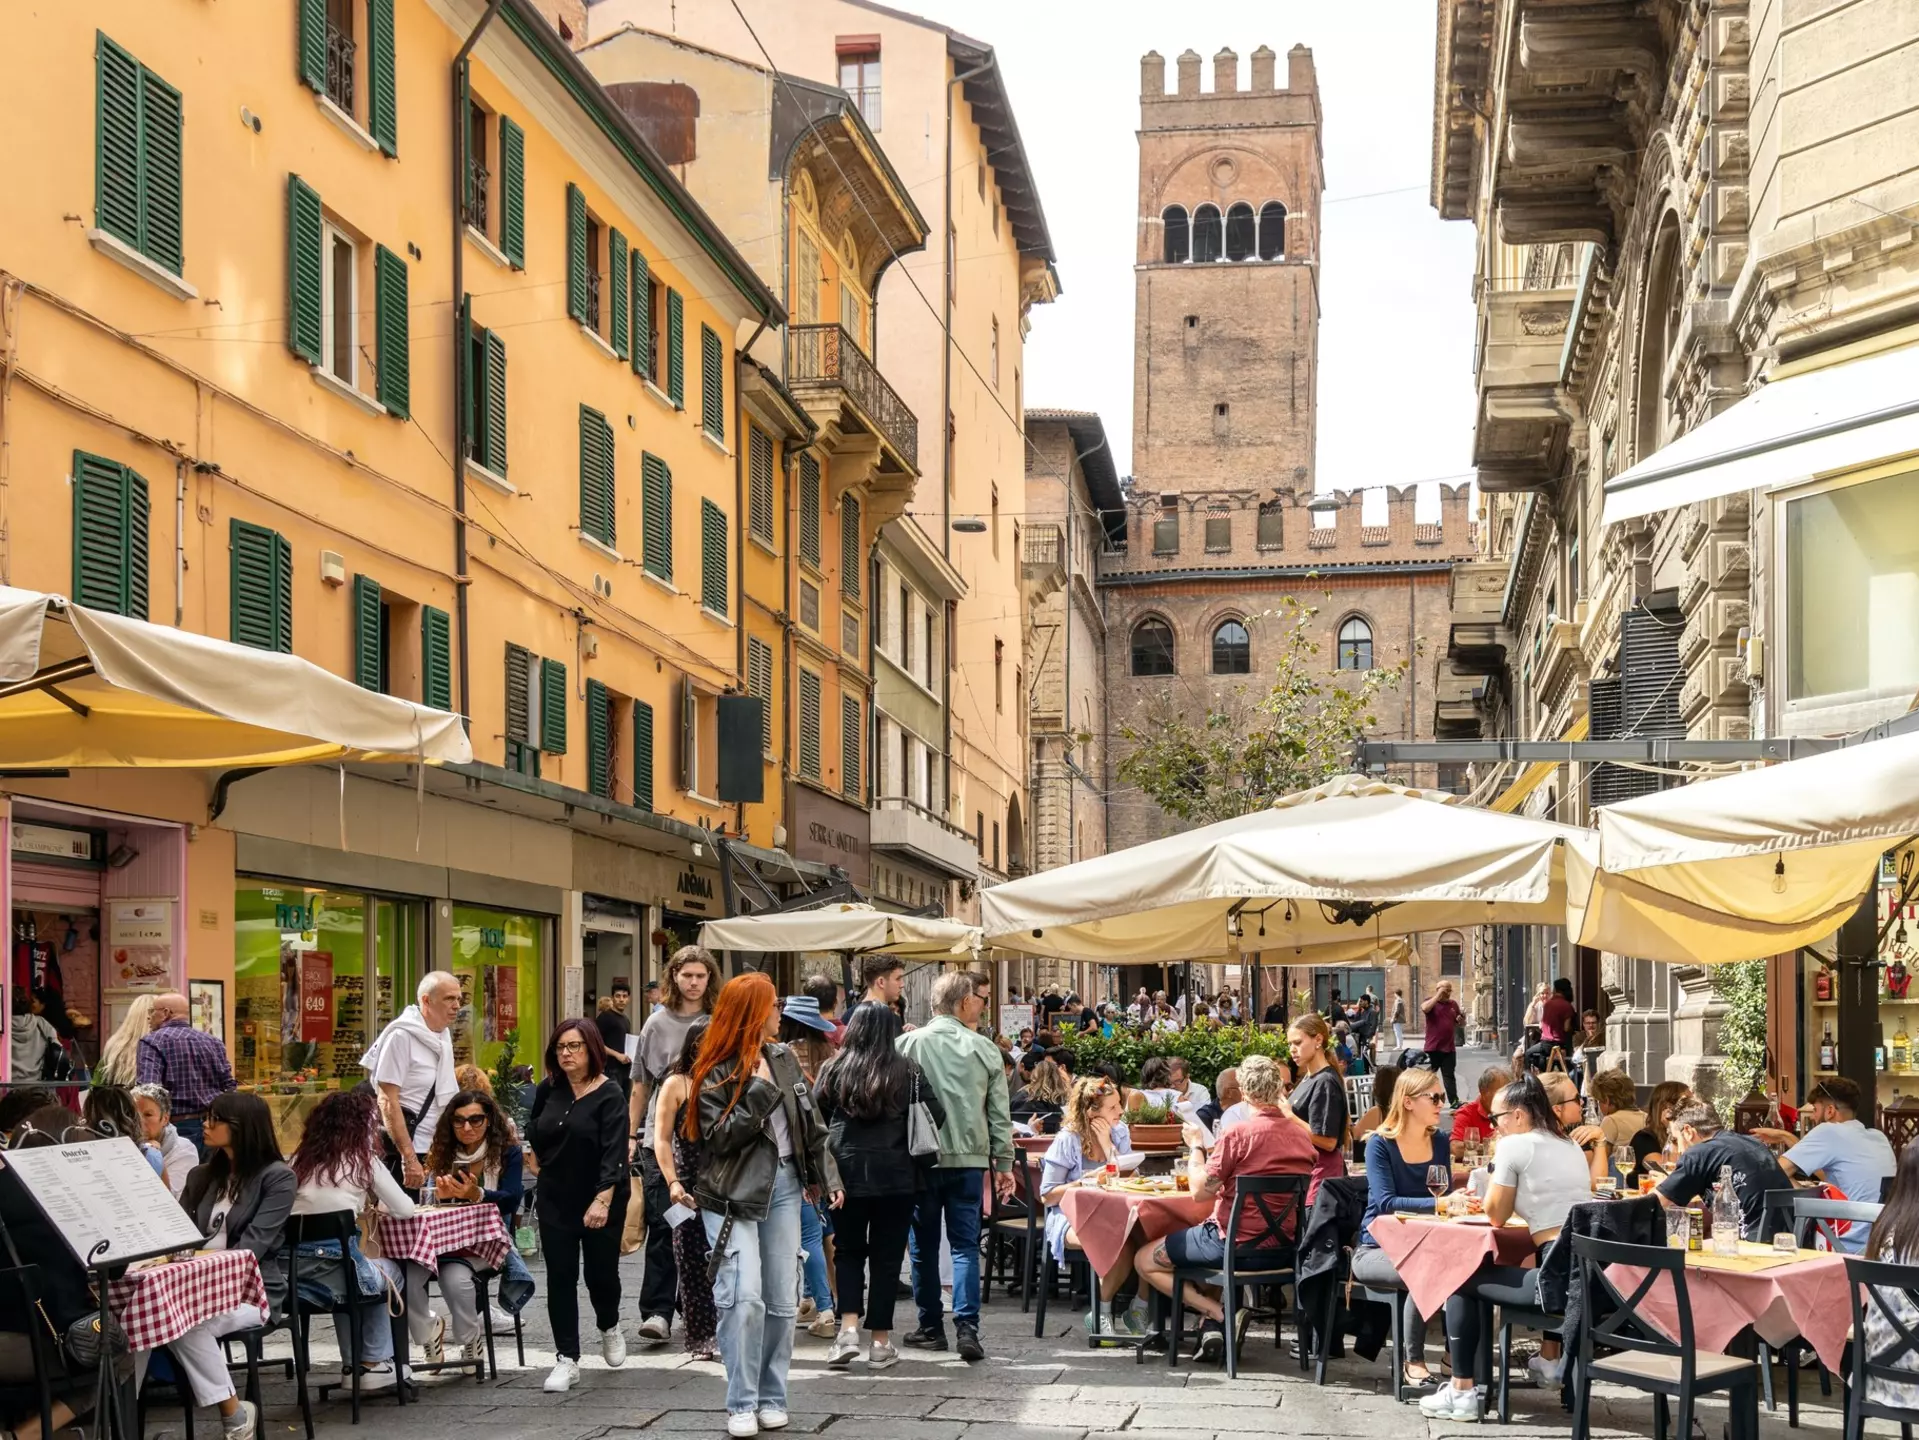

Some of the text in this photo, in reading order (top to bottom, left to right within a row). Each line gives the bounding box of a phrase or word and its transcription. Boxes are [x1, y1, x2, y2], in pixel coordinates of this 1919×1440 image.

[676, 872, 714, 900] AROMA
[305, 971, 321, 980] BACK
[305, 997, 325, 1011] €49
[61, 1148, 89, 1158] Osteria
